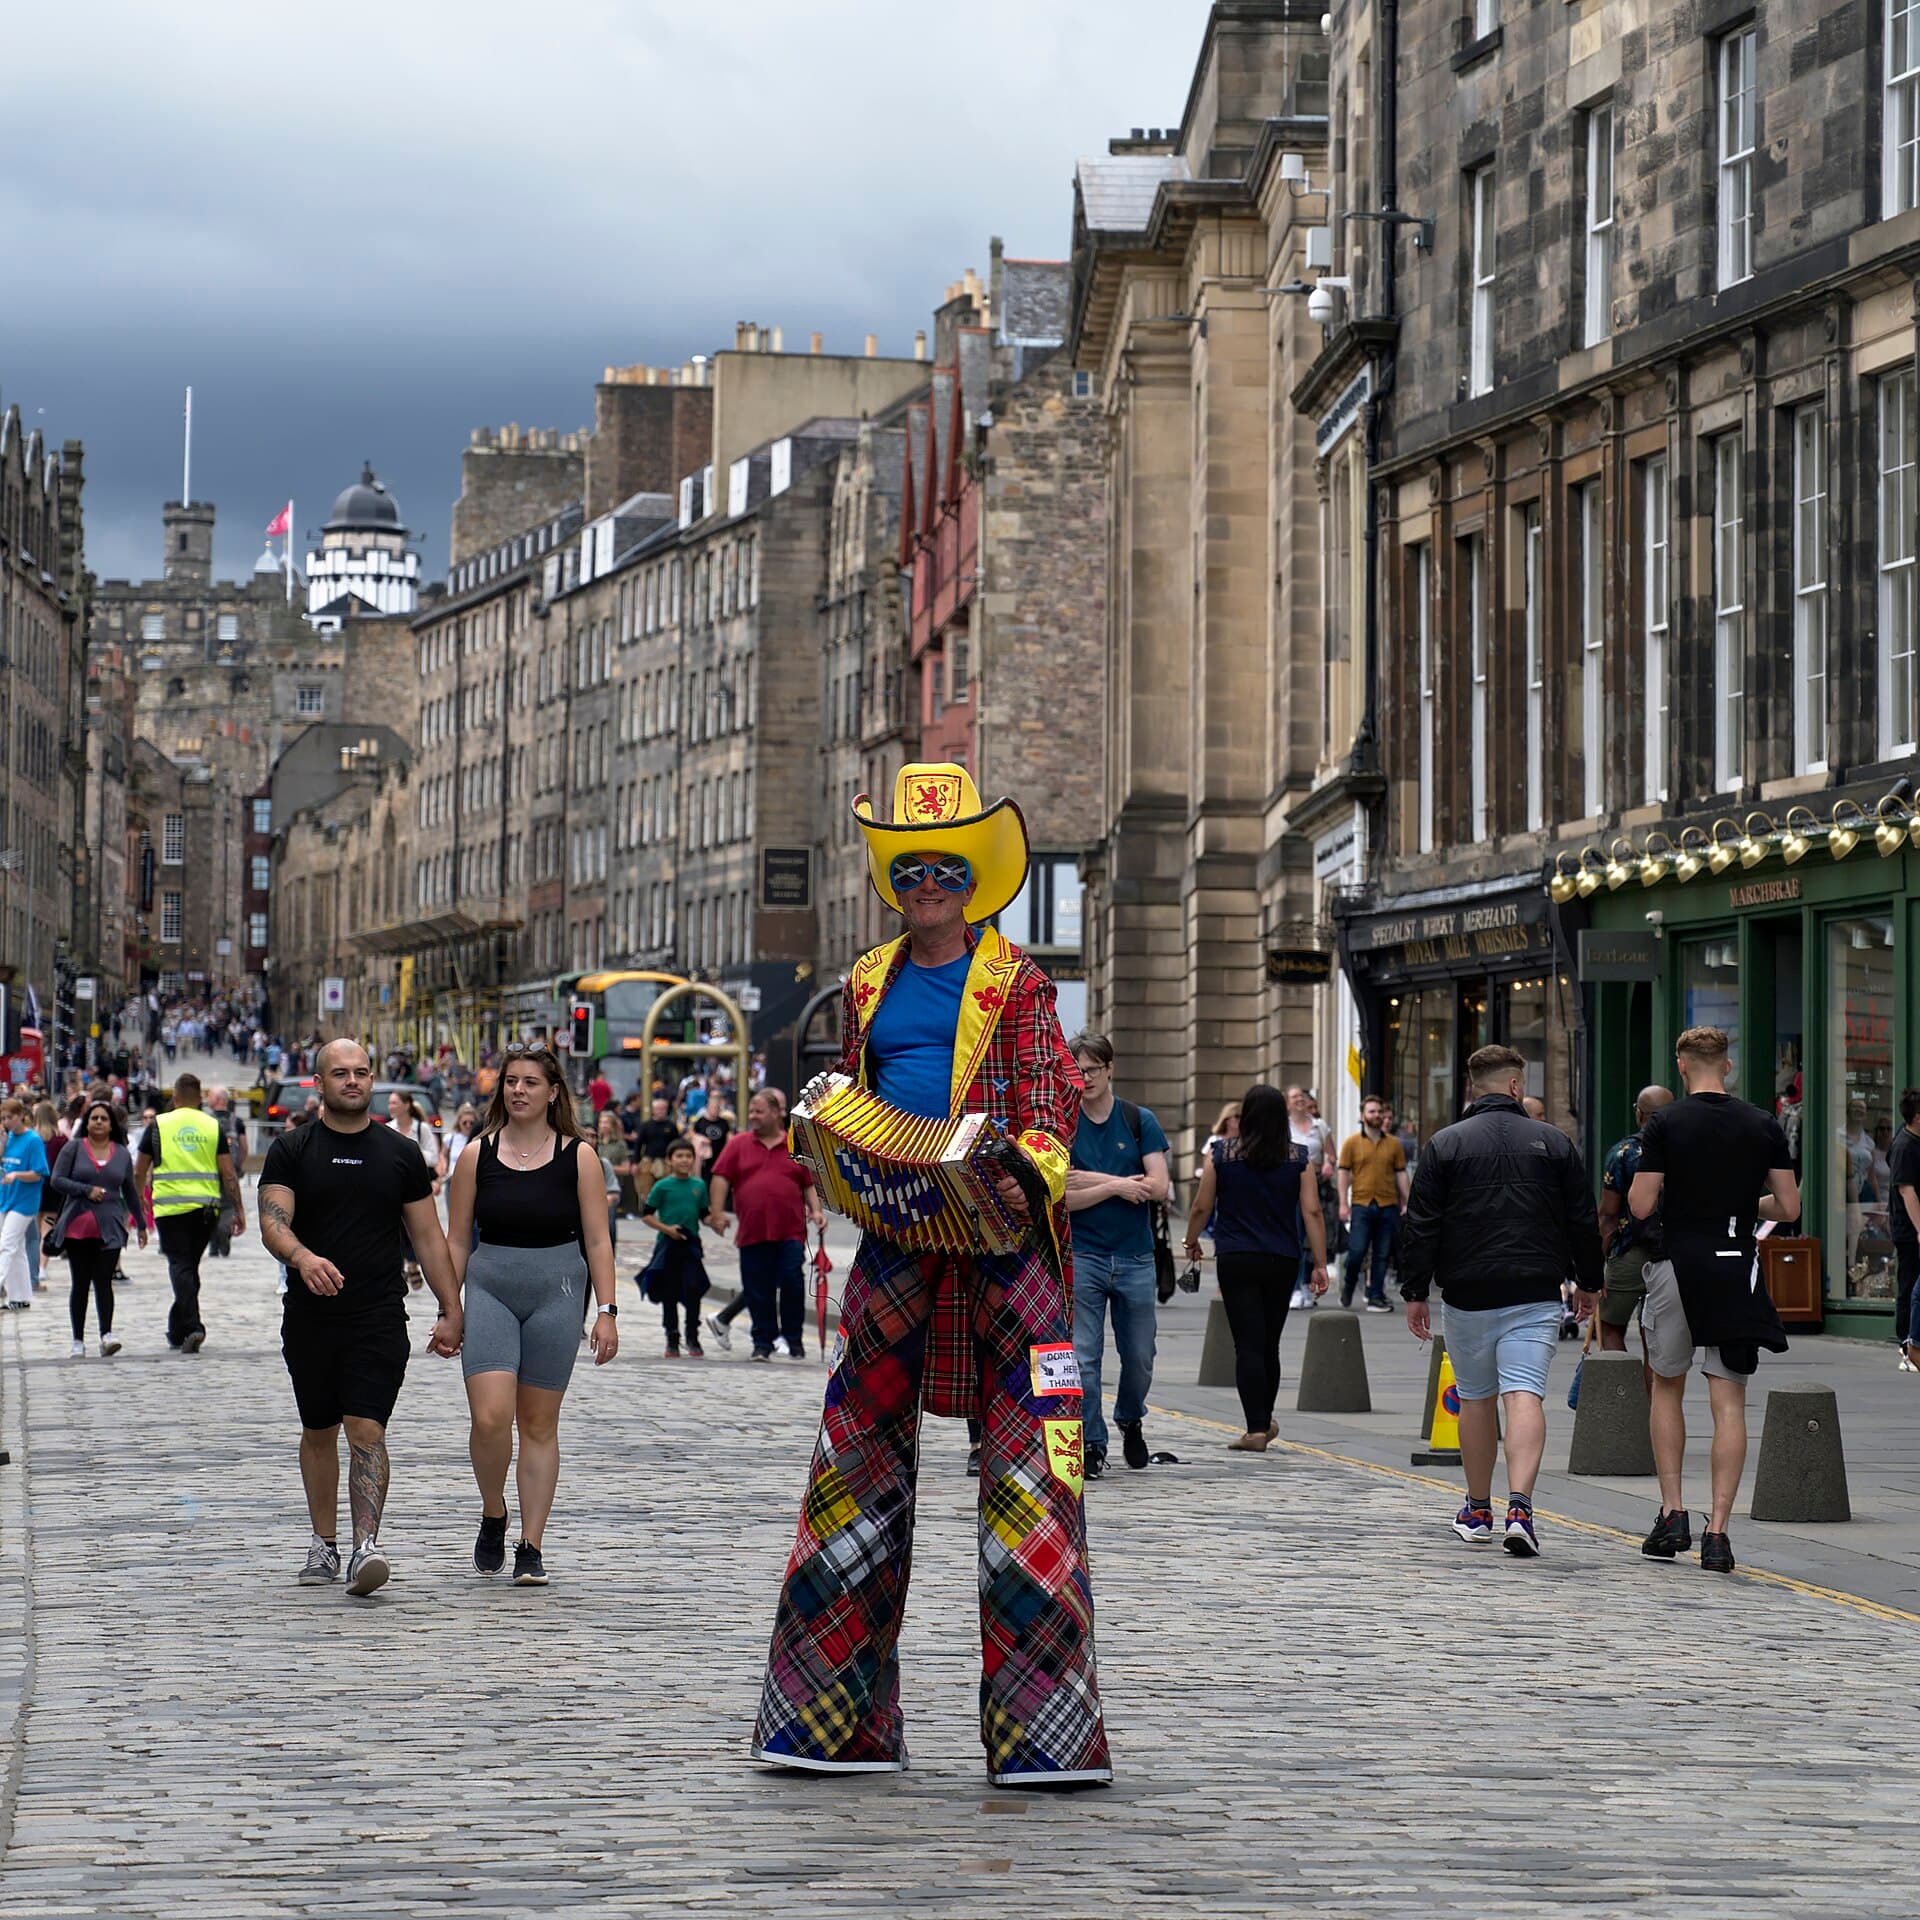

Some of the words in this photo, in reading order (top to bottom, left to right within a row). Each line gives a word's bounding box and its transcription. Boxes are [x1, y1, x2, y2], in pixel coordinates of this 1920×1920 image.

[1729, 878, 1800, 907] MARCHBRAE
[1372, 919, 1417, 947] SPECIALIST
[1463, 904, 1518, 932] MERCHANTS
[1404, 941, 1440, 965] ROYAL
[1444, 933, 1471, 961] MILE
[1474, 927, 1528, 955] WHISKIES
